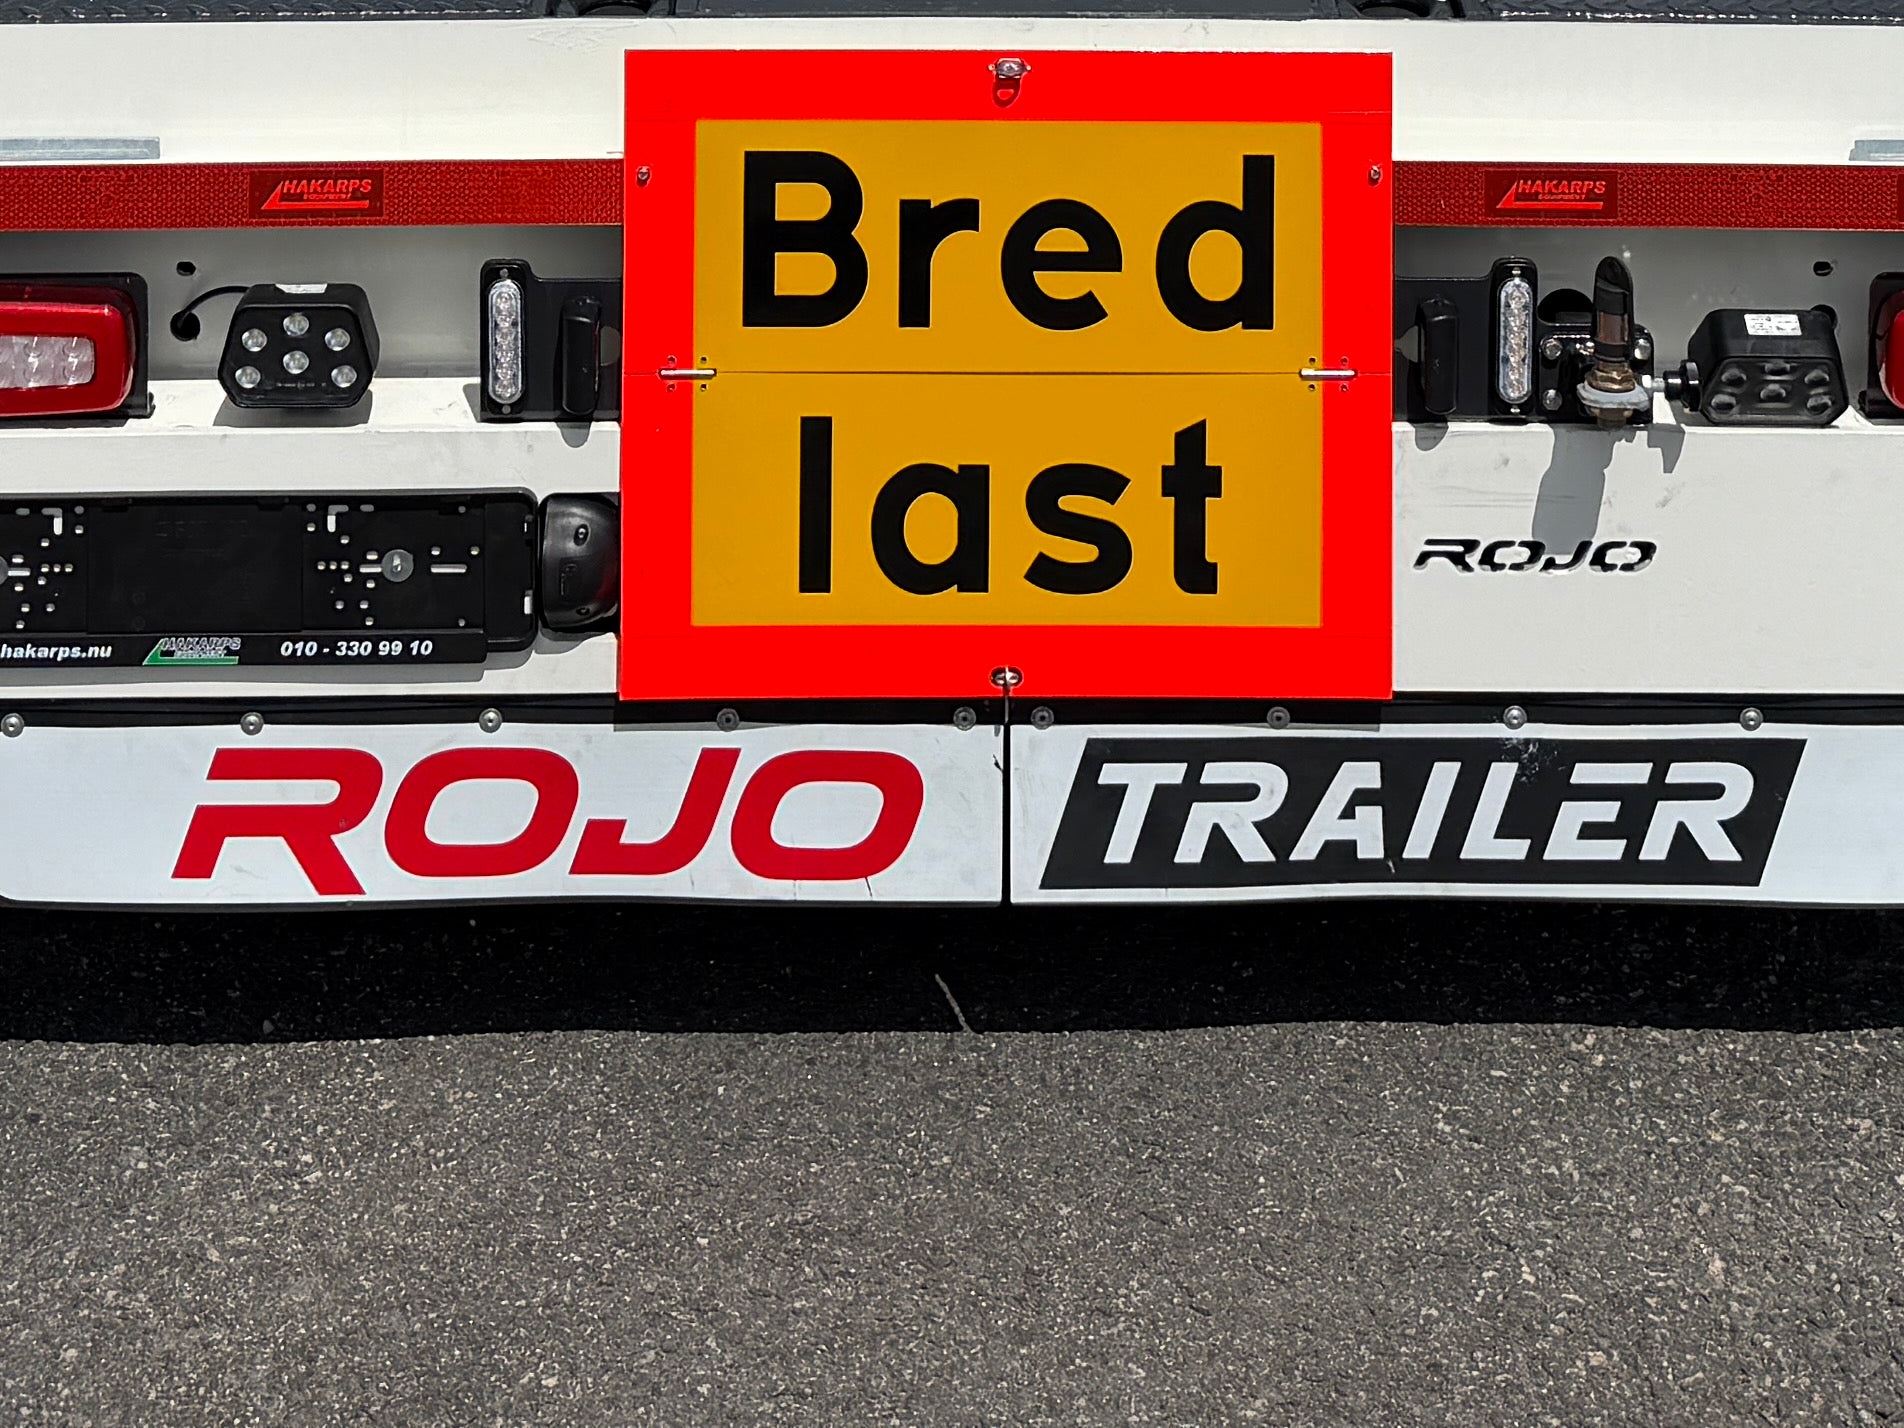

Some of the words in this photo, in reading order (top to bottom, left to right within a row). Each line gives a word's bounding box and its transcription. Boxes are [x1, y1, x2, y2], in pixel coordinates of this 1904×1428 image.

[282, 179, 372, 193] HAKARPS
[1518, 180, 1606, 194] HAKARPS
[741, 150, 1276, 332] Bred
[798, 415, 1223, 596] last
[1412, 538, 1658, 575] ROJO
[280, 641, 318, 657] 010
[335, 641, 373, 656] 330
[378, 640, 403, 656] 99
[409, 640, 434, 655] 10
[171, 746, 925, 896] ROJO
[1096, 760, 1756, 864] TRAILER
